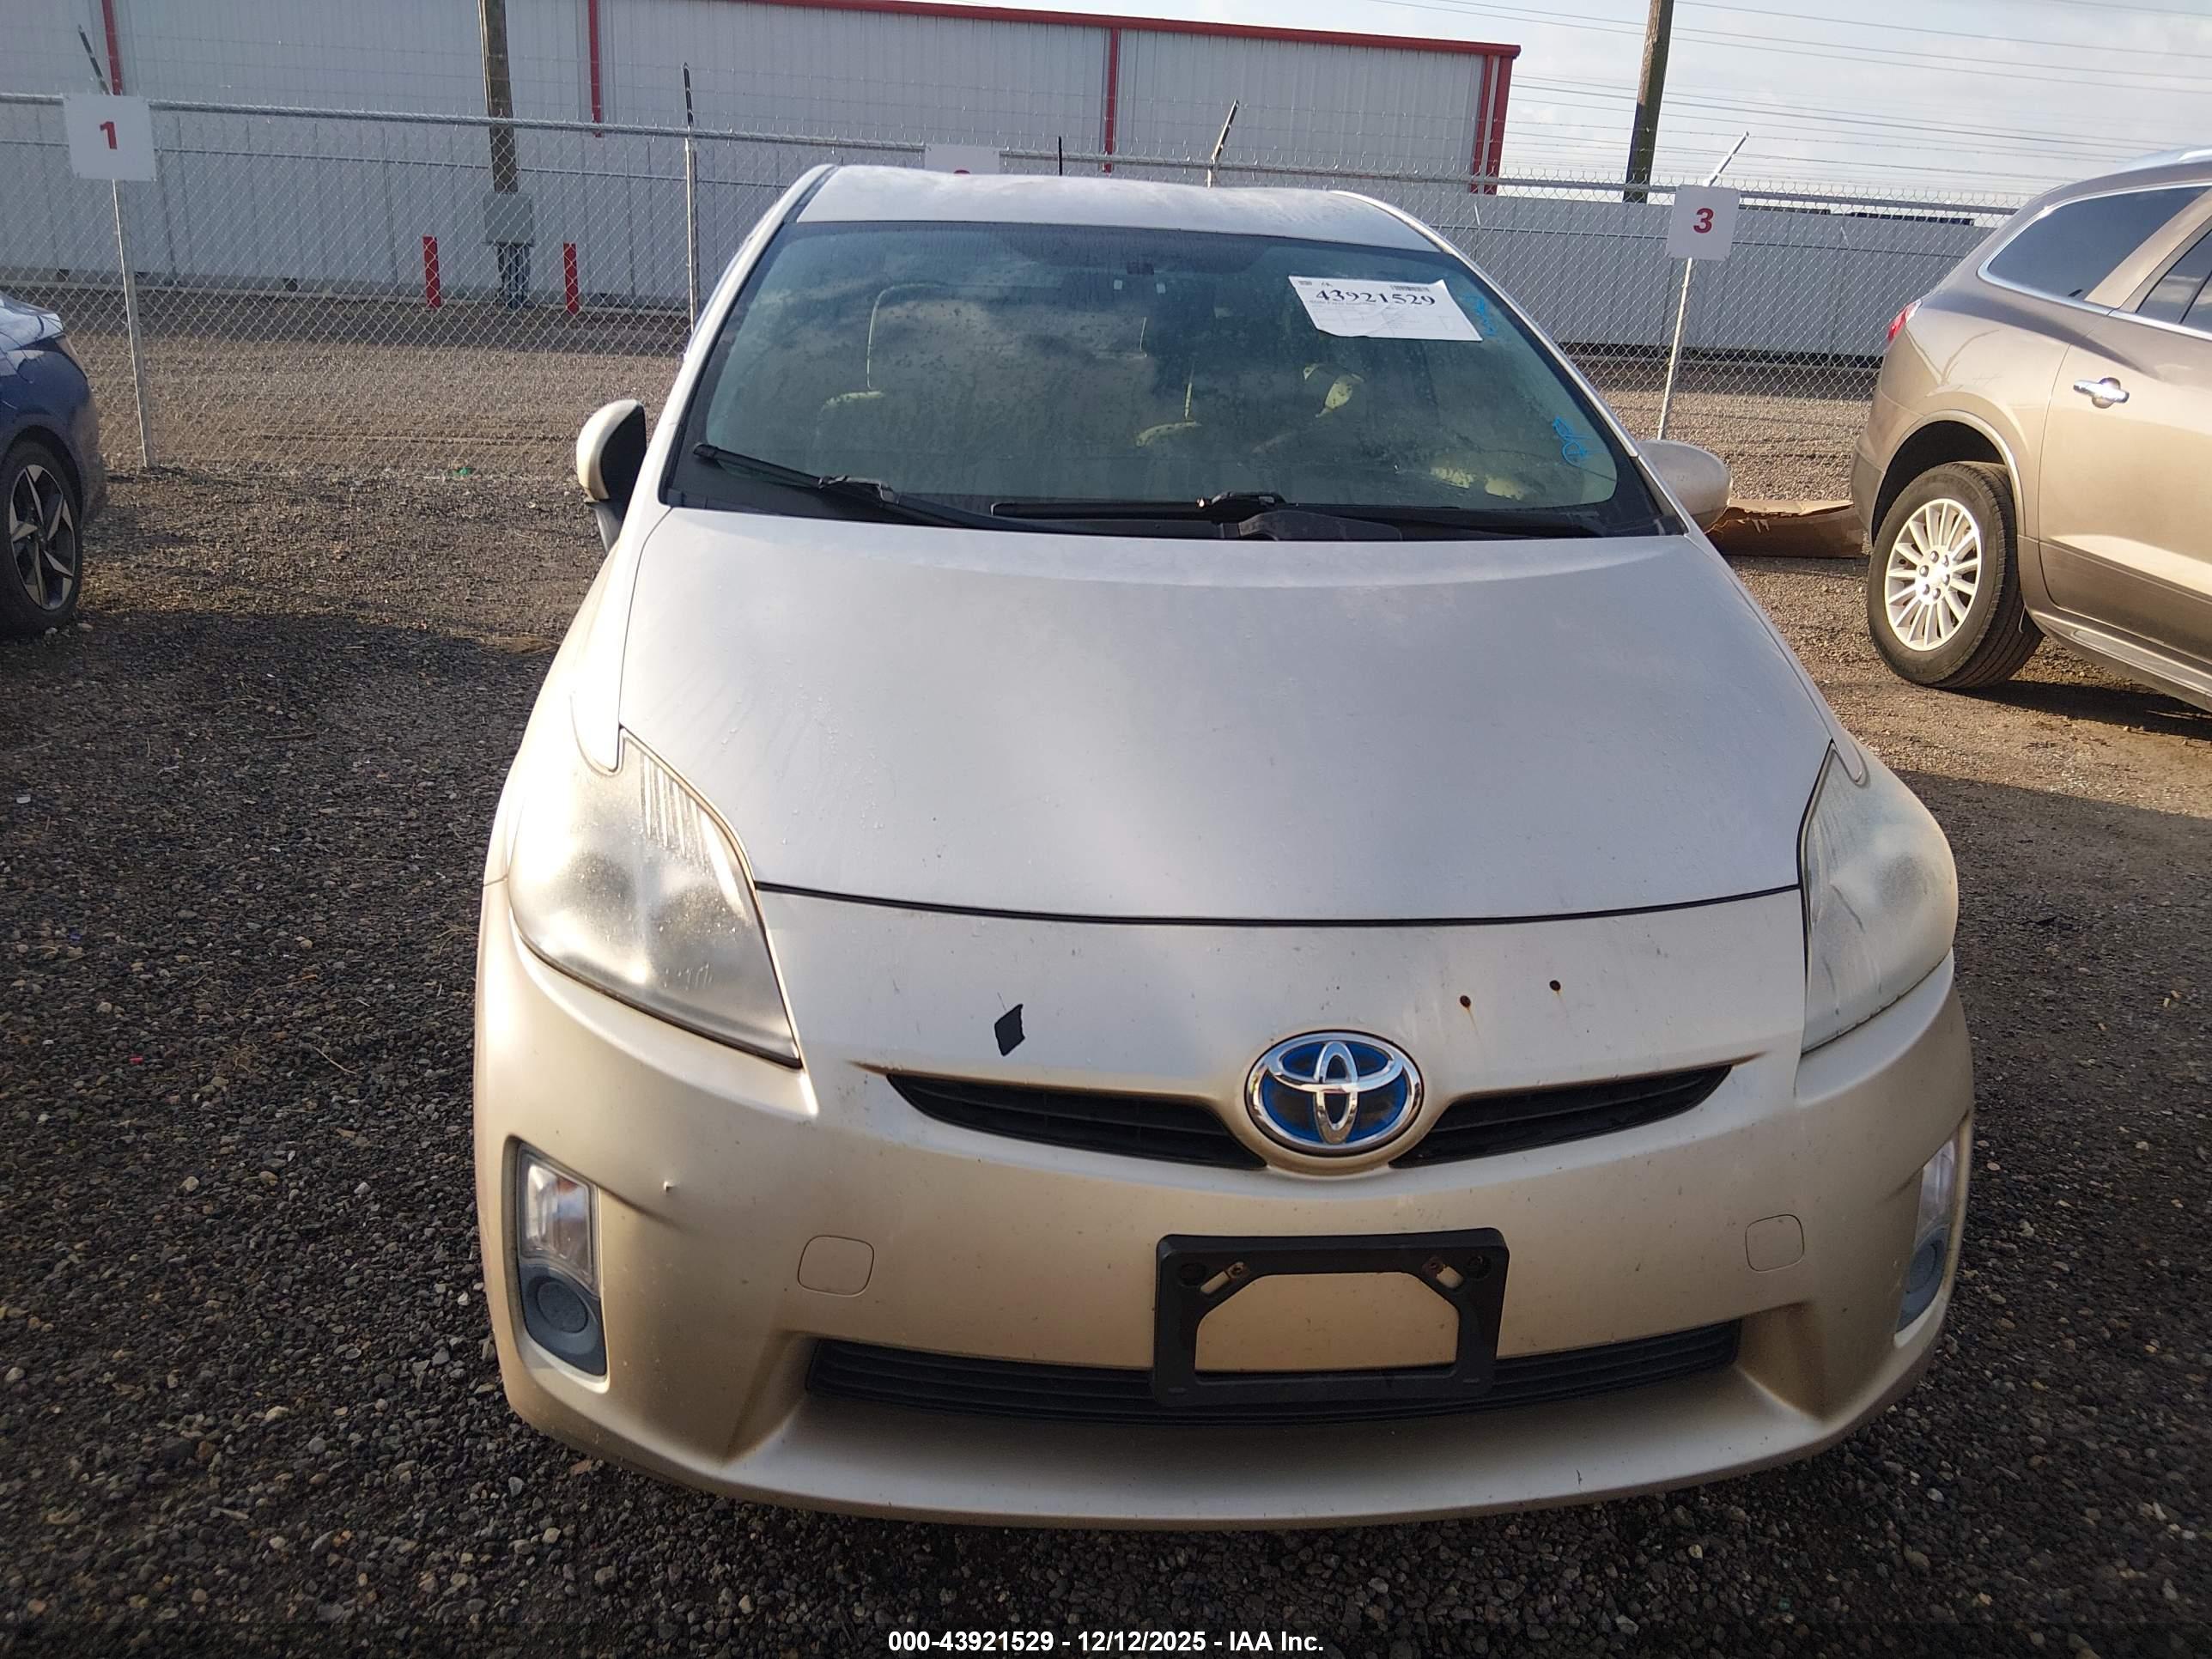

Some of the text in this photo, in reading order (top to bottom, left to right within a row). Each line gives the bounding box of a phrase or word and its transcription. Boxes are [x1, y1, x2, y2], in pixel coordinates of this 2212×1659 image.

[100, 121, 118, 150] 1
[1692, 208, 1714, 234] 3
[1316, 289, 1436, 306] 43921529
